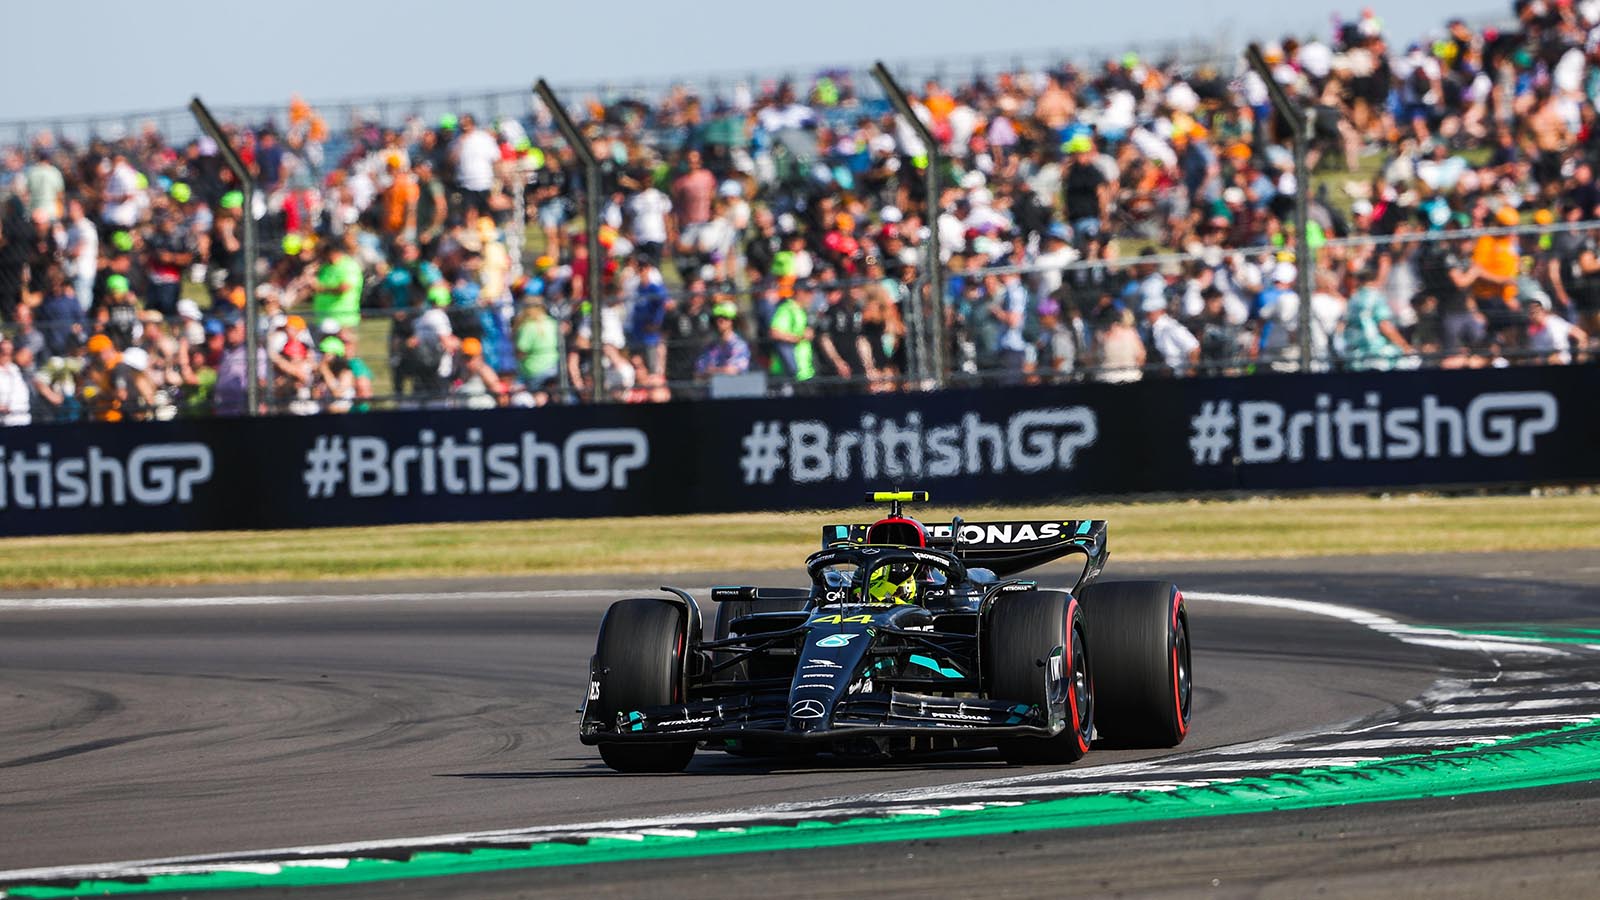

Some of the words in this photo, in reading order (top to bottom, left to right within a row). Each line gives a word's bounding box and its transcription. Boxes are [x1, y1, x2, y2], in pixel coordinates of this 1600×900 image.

[304, 428, 648, 497] #BritishGP
[740, 405, 1097, 484] #BritishGP
[1190, 391, 1558, 466] #BritishGP
[811, 614, 875, 624] 44
